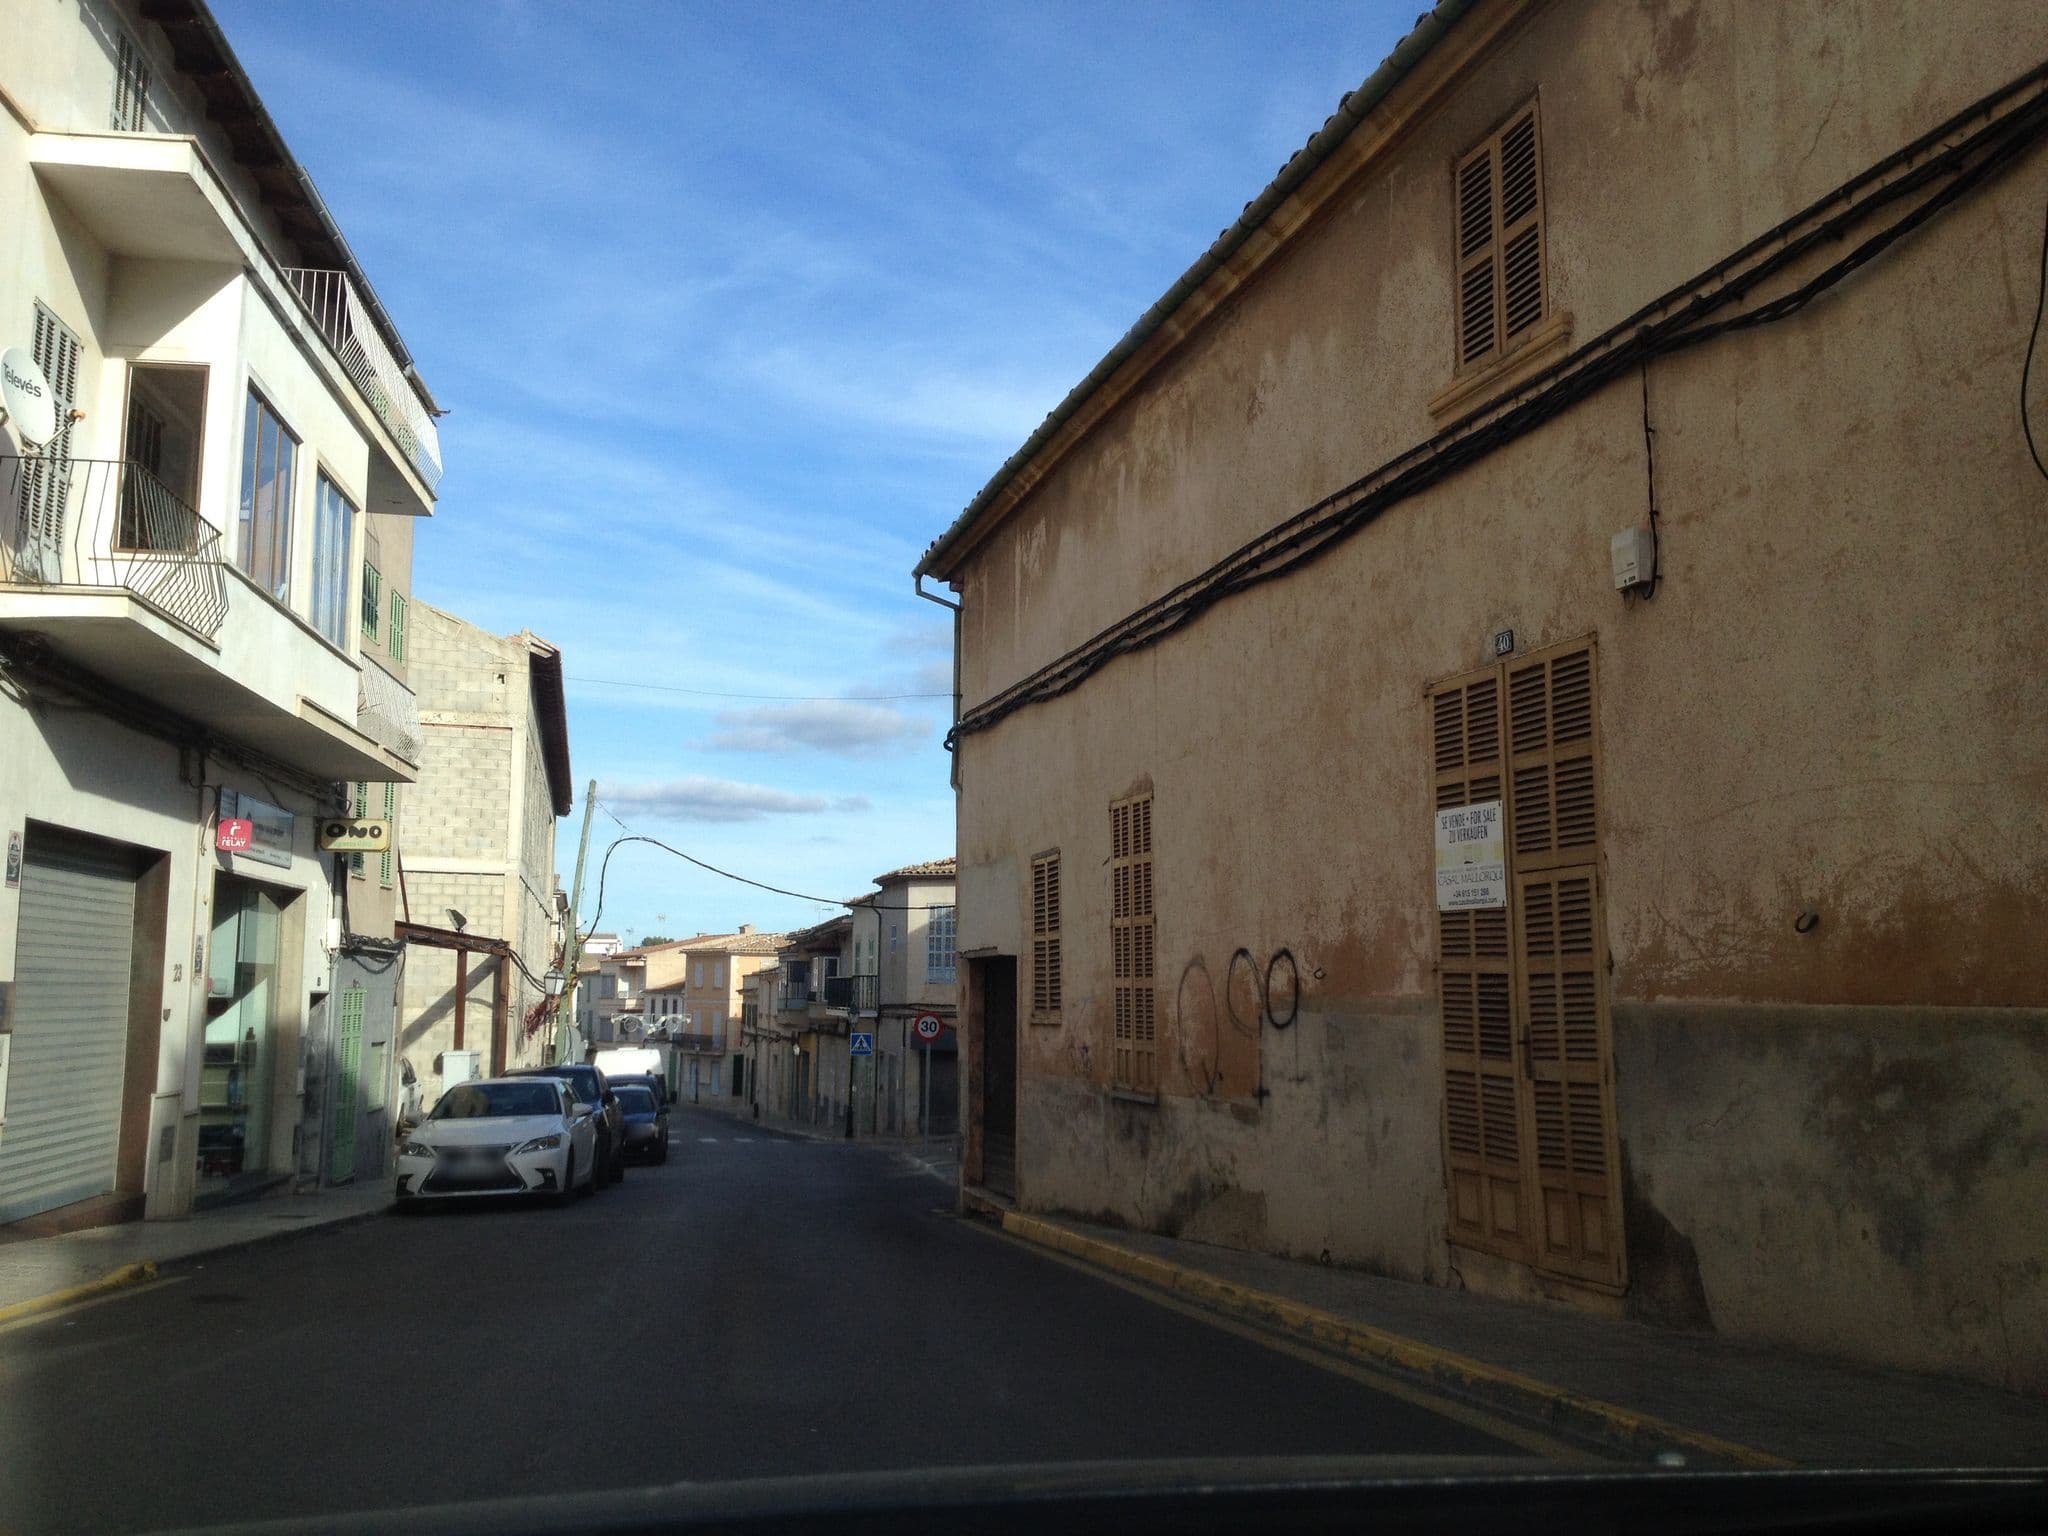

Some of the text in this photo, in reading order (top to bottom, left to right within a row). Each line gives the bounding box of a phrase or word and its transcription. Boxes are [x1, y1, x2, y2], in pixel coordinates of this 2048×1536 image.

[3, 363, 42, 398] Televés
[1496, 636, 1509, 651] 40
[1441, 807, 1497, 830] SE VENDE FOR SALE
[1448, 825, 1488, 844] ZU VERKAUFEN
[920, 1021, 937, 1033] 30
